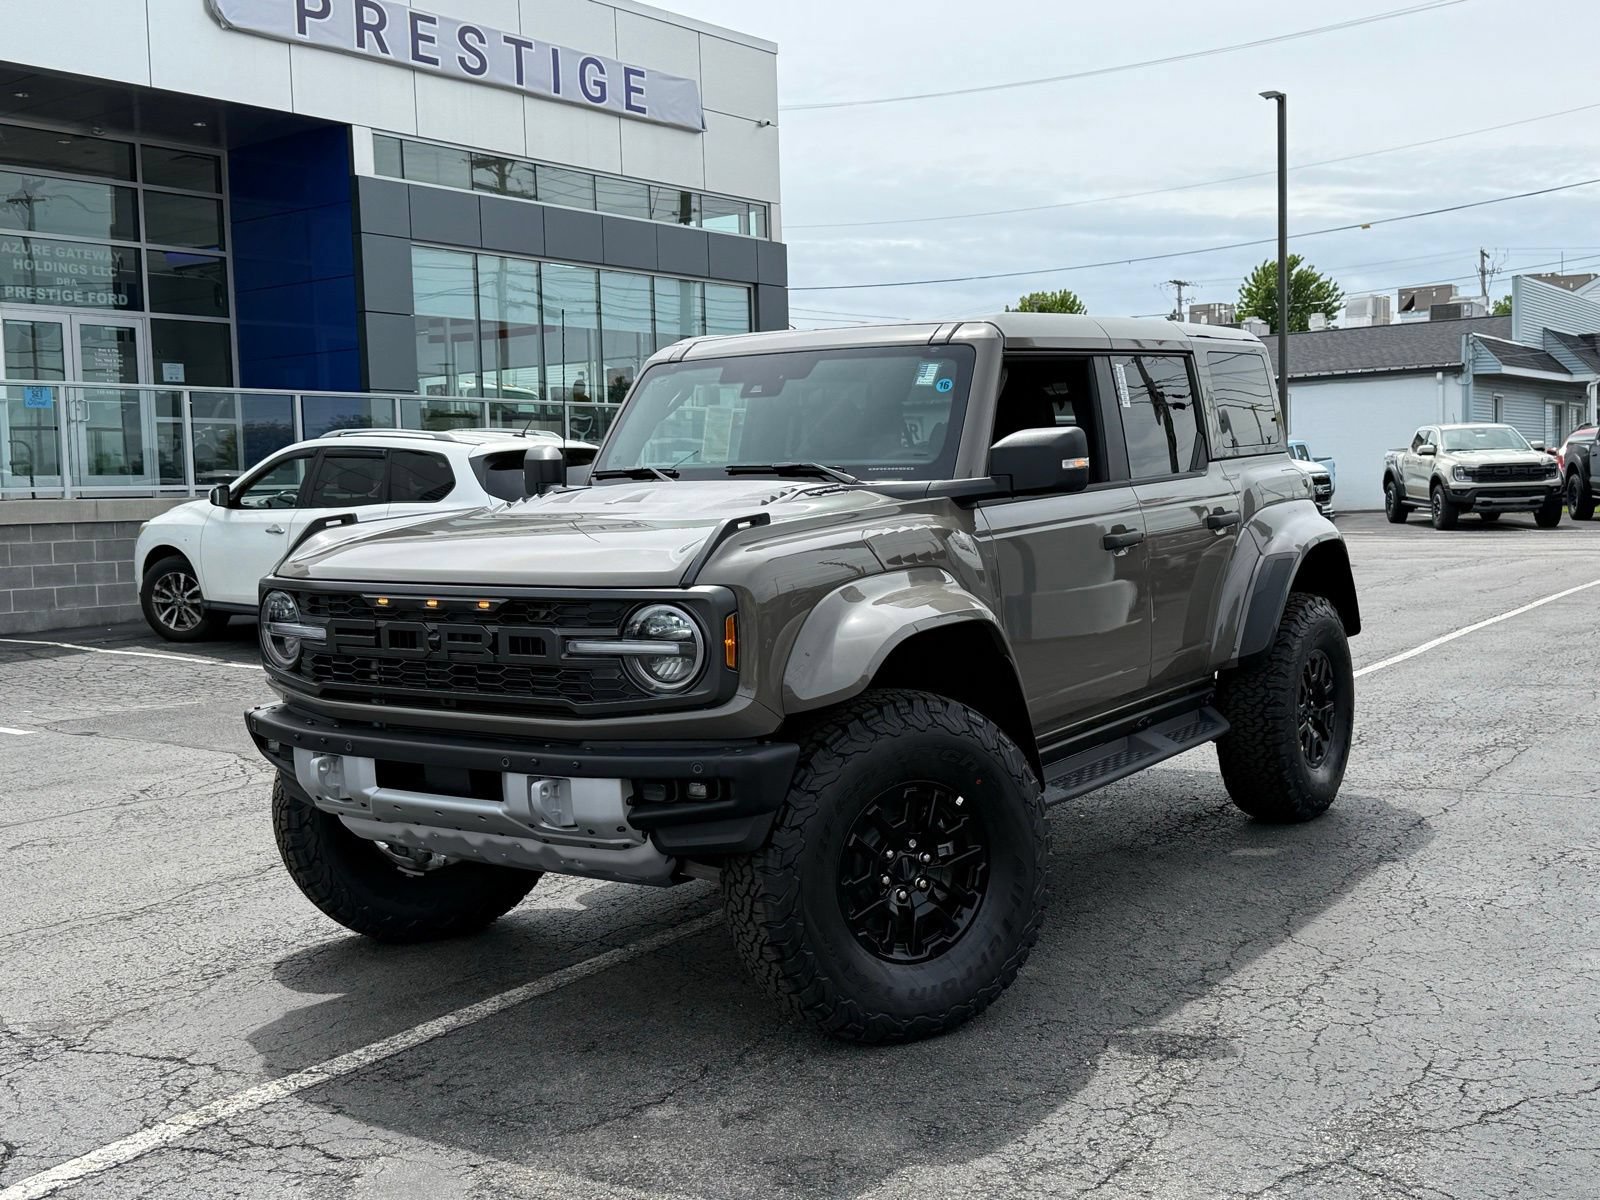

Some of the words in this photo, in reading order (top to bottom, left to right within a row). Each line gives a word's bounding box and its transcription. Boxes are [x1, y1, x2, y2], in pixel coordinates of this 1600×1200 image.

[295, 0, 648, 115] PRESTIGE
[1, 241, 51, 256] AZURE
[55, 247, 122, 262] GATEWAY
[14, 259, 88, 274] HOLDINGS
[4, 286, 83, 303] PRESTIGE
[88, 292, 128, 306] FORD
[939, 381, 950, 390] 16
[326, 617, 559, 665] FORD
